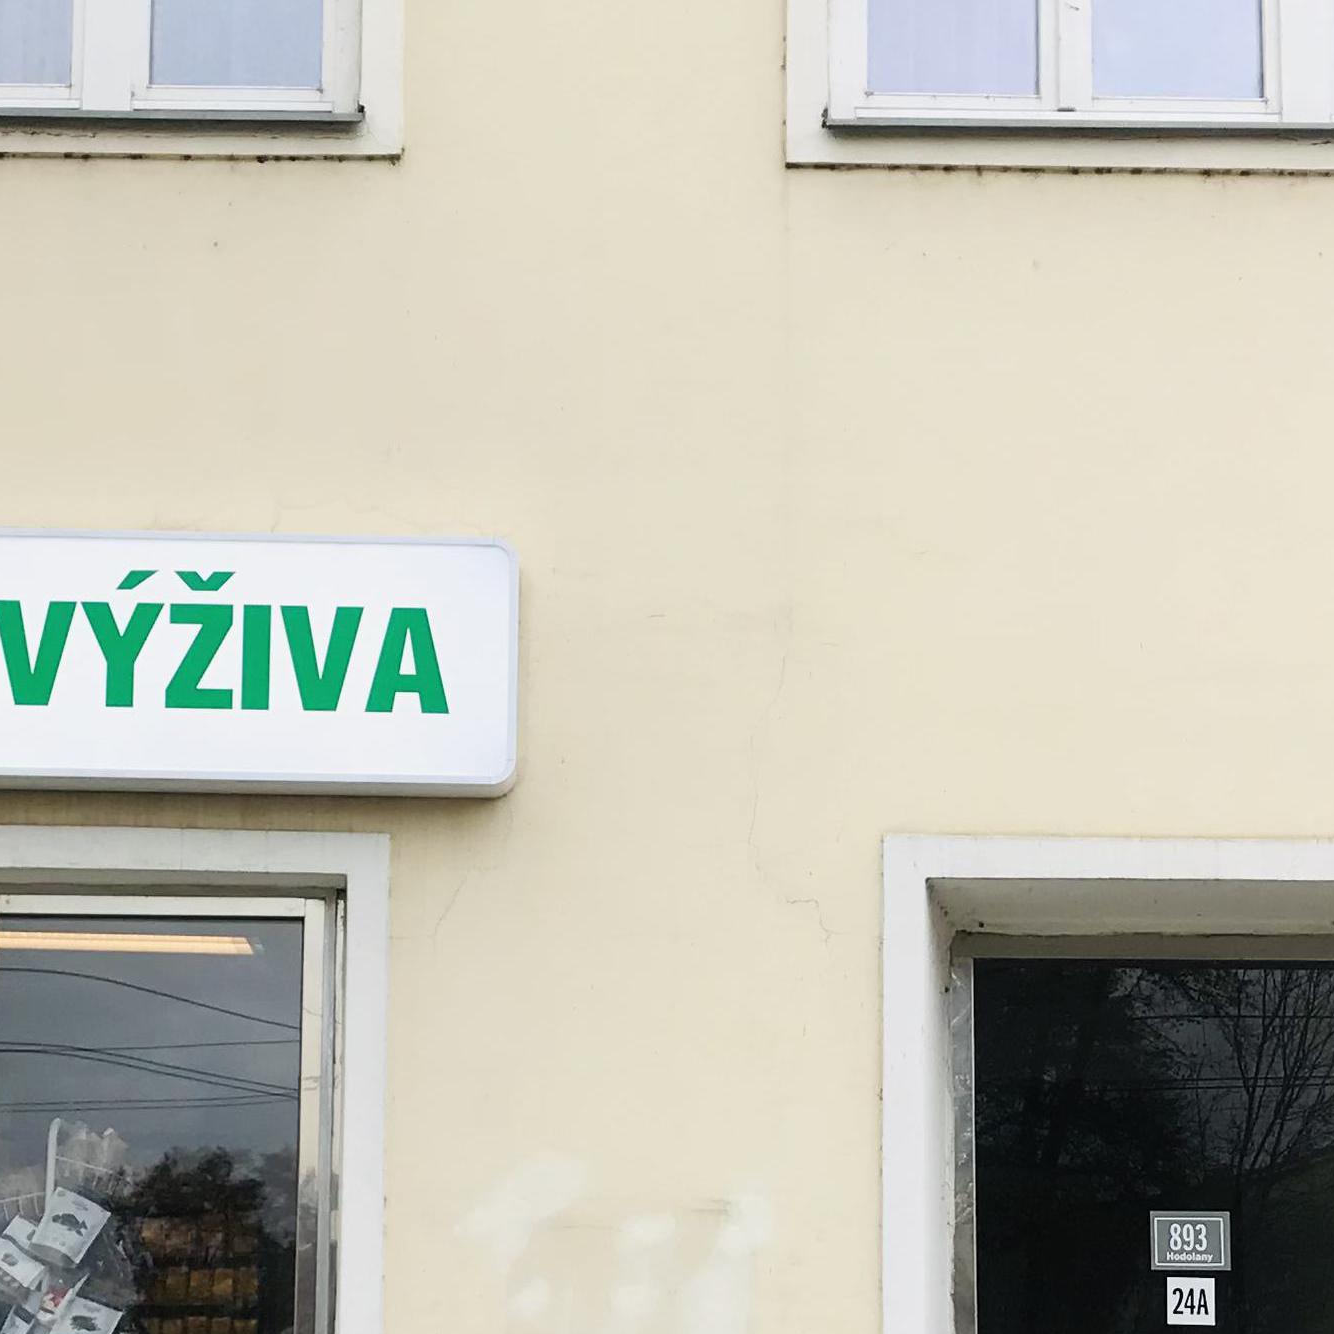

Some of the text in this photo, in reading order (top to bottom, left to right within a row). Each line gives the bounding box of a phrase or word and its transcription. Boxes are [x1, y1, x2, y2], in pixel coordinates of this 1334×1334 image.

[1169, 1223, 1207, 1251] 893
[1166, 1251, 1214, 1263] Hodolany
[1172, 1287, 1209, 1315] 24A
